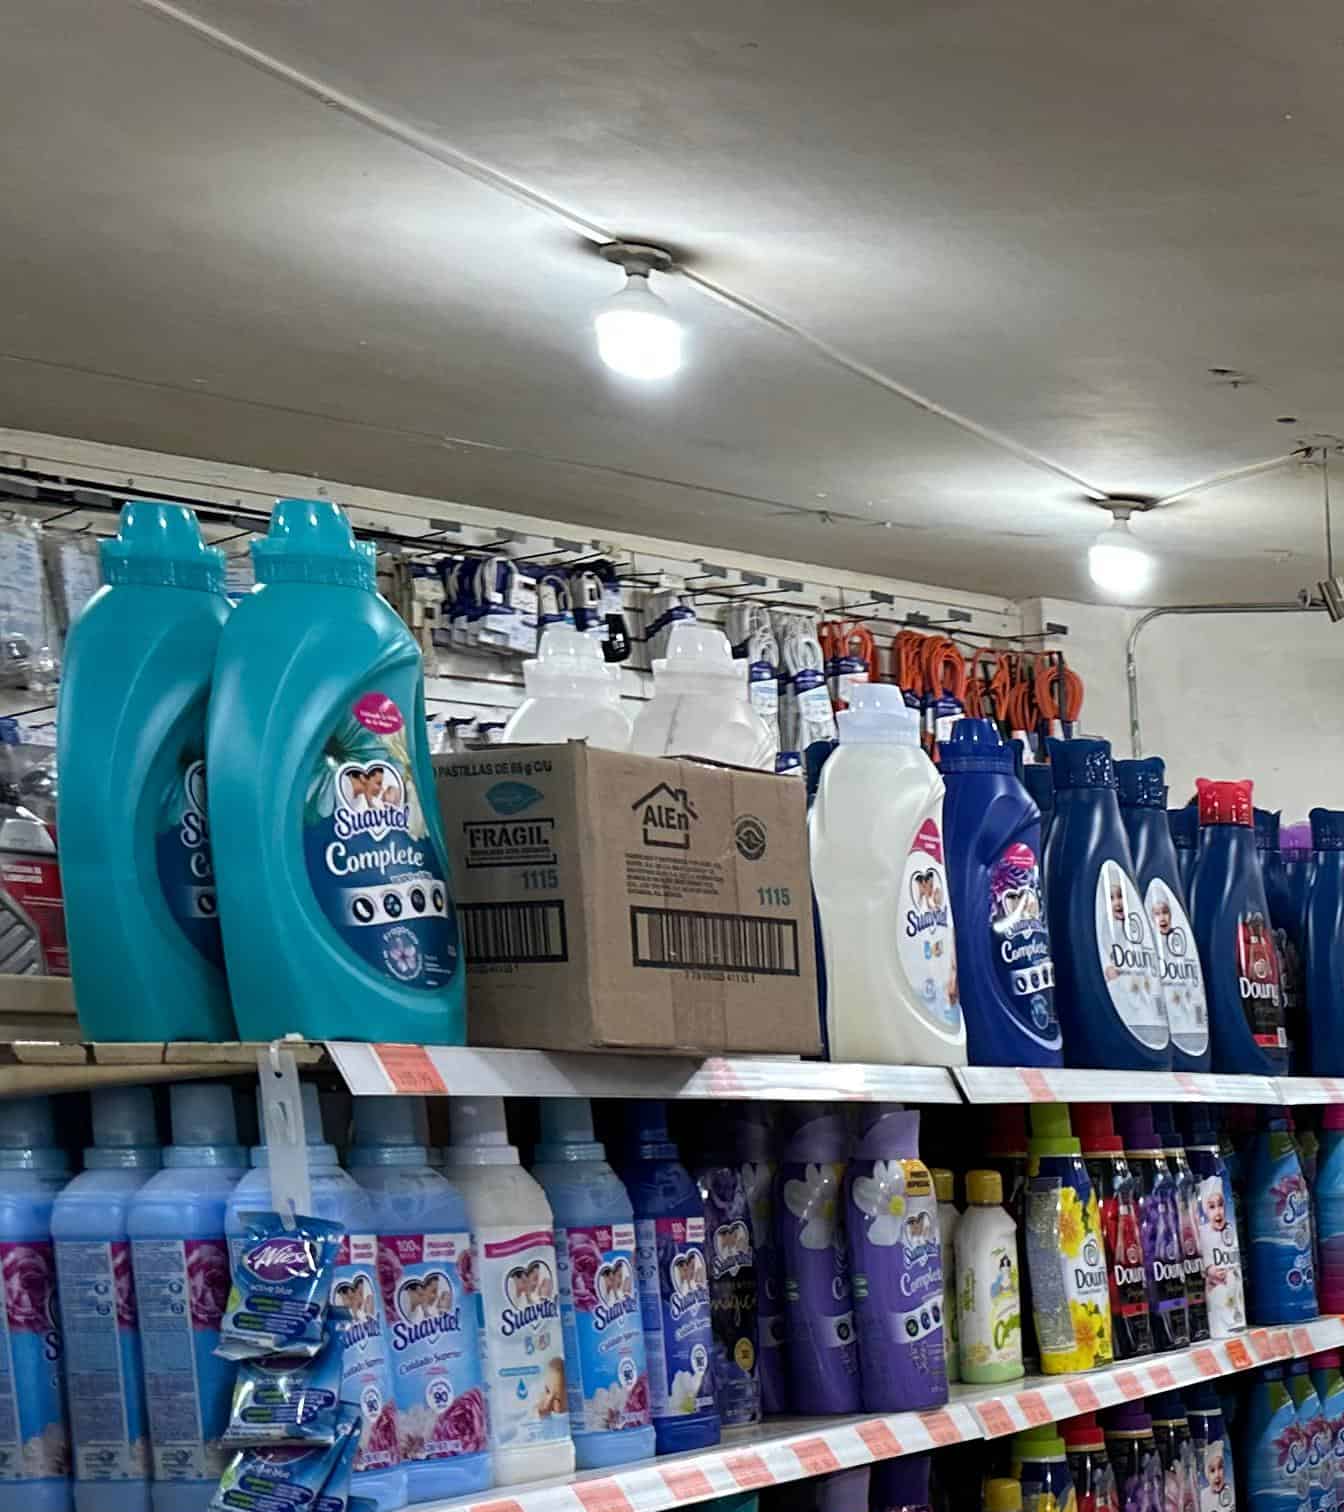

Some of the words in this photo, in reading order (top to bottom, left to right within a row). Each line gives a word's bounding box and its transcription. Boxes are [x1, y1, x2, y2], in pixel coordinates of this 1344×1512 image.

[335, 805, 410, 839] Suavitel
[643, 805, 688, 830] AlEn
[326, 842, 424, 875] Complete
[522, 871, 558, 888] 1115
[757, 887, 790, 906] 1115
[1239, 977, 1279, 1007] Downy
[392, 1308, 461, 1351] Suavitel
[501, 1294, 560, 1336] Suavitel
